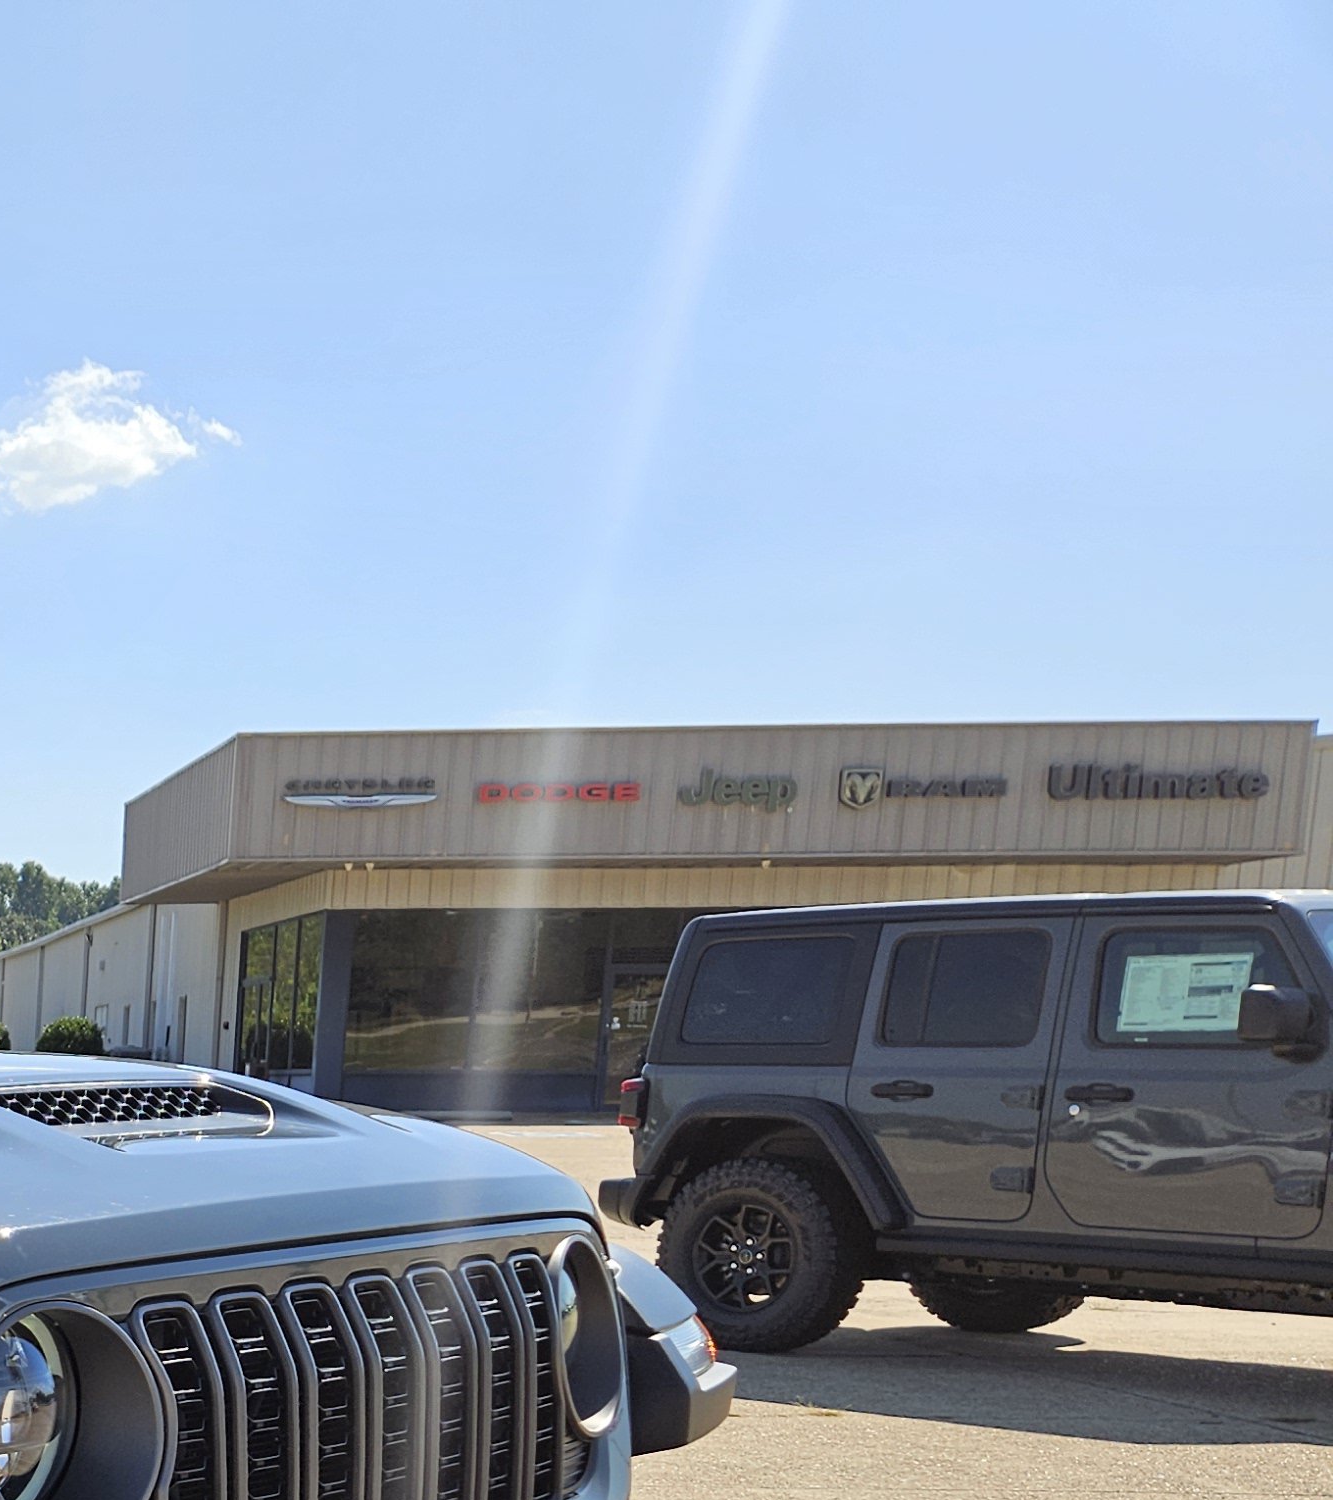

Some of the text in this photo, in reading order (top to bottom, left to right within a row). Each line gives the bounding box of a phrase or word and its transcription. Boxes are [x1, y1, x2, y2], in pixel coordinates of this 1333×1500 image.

[478, 781, 641, 805] DODGE
[678, 767, 798, 813] Jeep
[886, 778, 1008, 798] RAM
[1047, 763, 1271, 800] Ultimate
